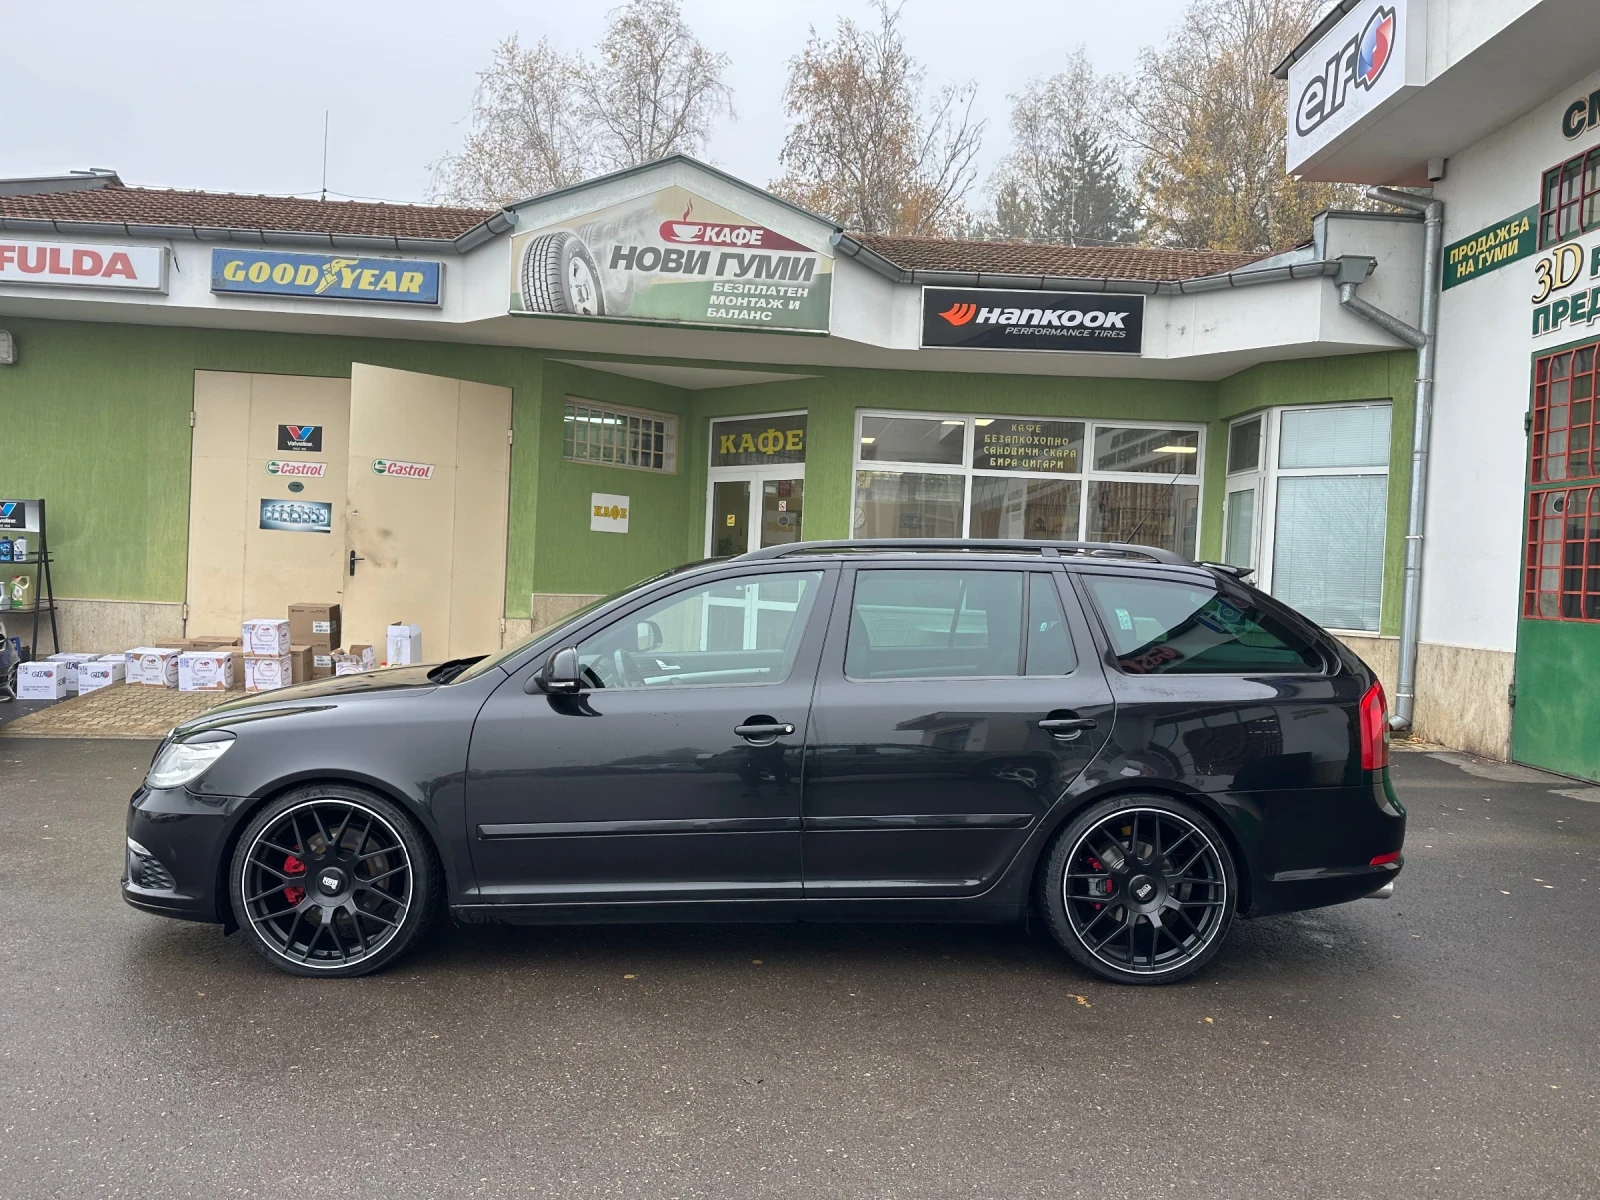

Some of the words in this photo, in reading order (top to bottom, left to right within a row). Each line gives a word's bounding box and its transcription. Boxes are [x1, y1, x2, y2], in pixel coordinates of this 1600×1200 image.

[703, 226, 764, 246] КАФЕ
[1450, 216, 1530, 265] ПРОДАЖБА
[0, 244, 138, 280] FULDA
[609, 245, 711, 275] НОВИ
[715, 251, 817, 283] ГУМИ
[1456, 262, 1475, 278] НА
[1478, 239, 1519, 269] ГУМИ
[1531, 242, 1585, 304] 3D
[712, 282, 809, 298] БЕЗПЛАТЕН
[709, 295, 783, 310] МОНТАЖ
[788, 300, 801, 310] И
[706, 307, 773, 321] БАЛАНС
[1005, 326, 1090, 337] PERFORMANCE
[1094, 329, 1126, 338] TIRES
[1011, 423, 1042, 433] КАФЕ
[720, 428, 804, 455] КАФЕ
[280, 462, 322, 476] Castrol
[387, 462, 430, 478] Castrol
[593, 504, 627, 520] КАФЕ
